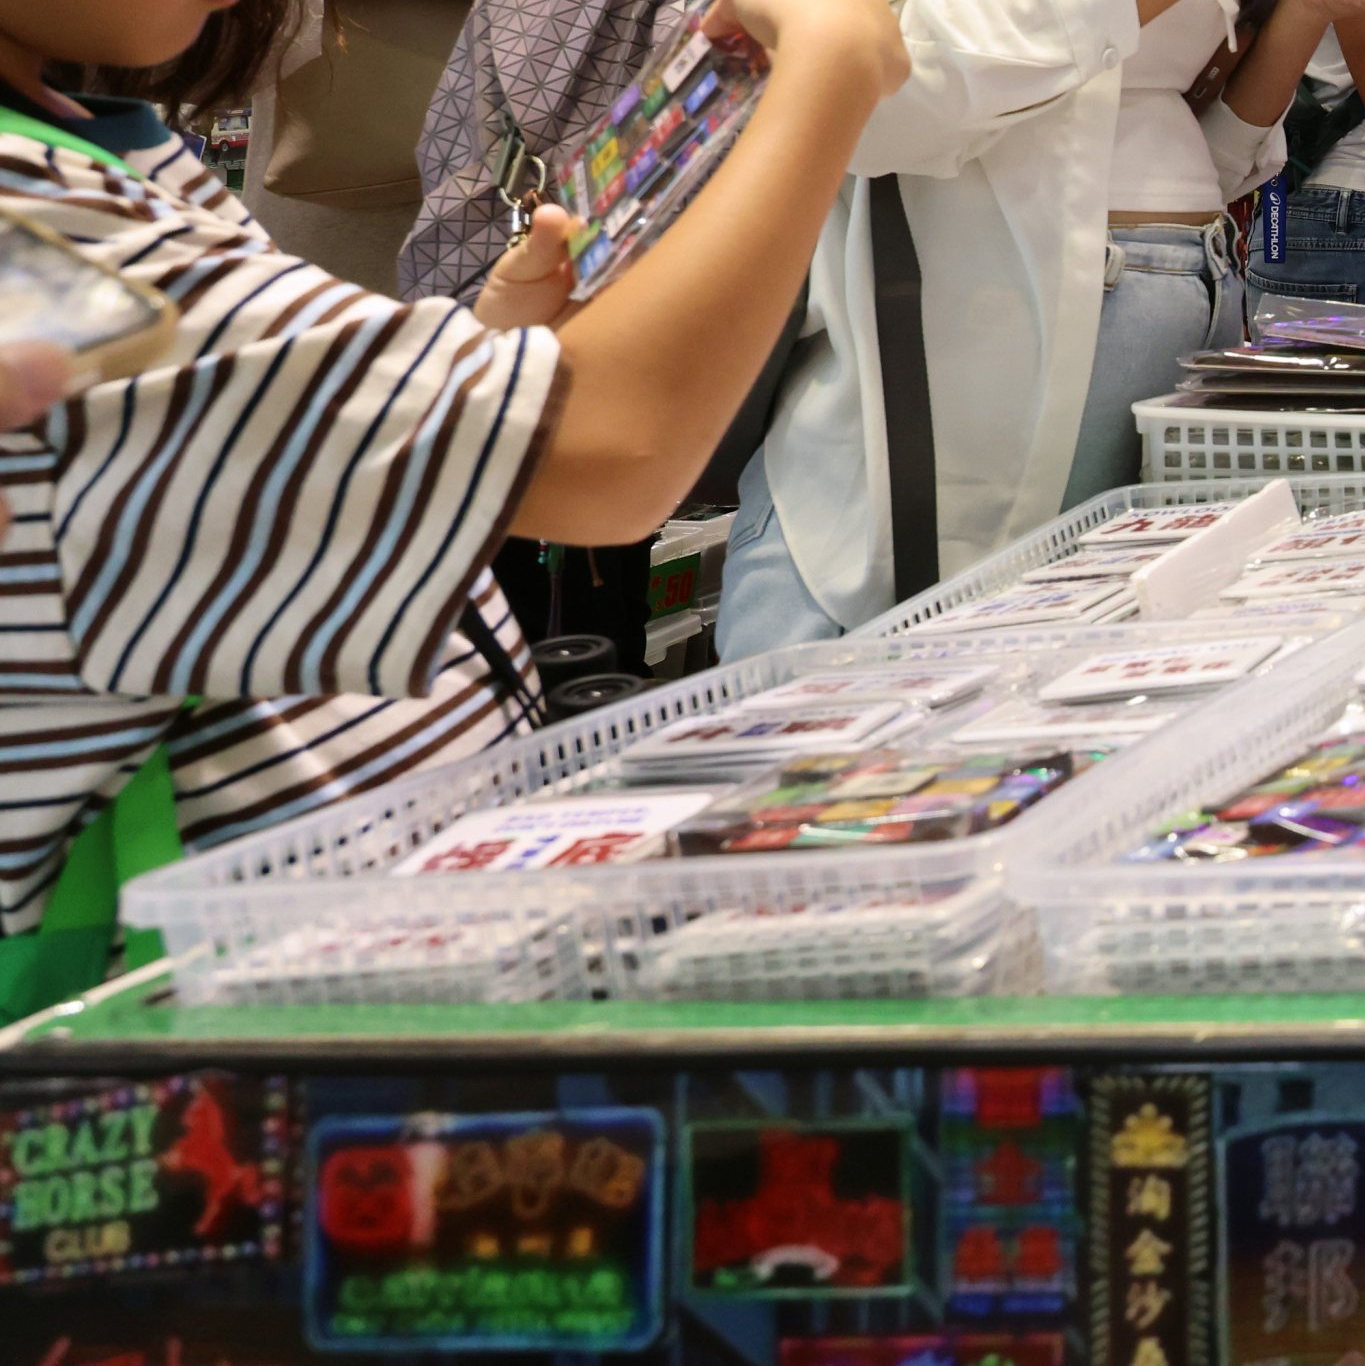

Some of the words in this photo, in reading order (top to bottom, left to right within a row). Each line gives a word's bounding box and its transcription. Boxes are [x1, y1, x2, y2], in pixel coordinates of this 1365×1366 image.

[1270, 205, 1279, 260] DECATHLON
[12, 1104, 160, 1175] CRAZY
[12, 1163, 160, 1230] HORSE
